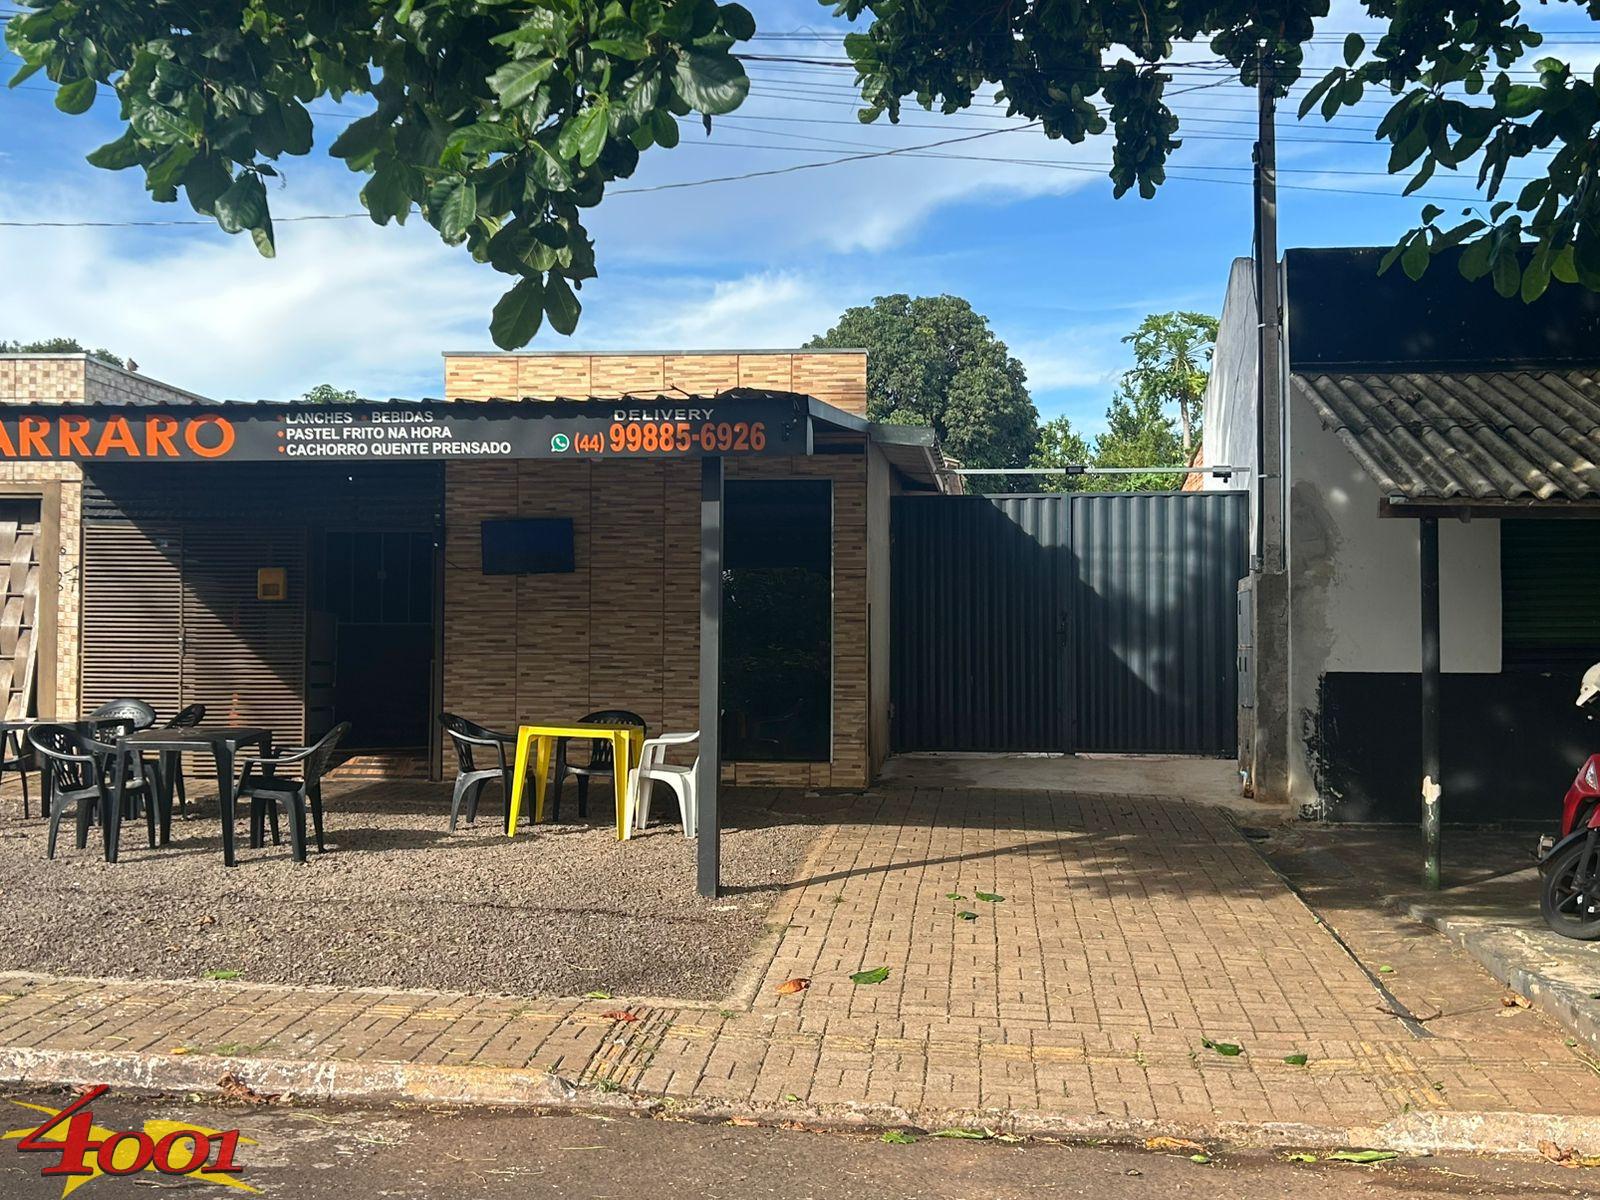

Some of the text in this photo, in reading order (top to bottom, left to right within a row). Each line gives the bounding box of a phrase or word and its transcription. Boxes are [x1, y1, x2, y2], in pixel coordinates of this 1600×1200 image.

[286, 410, 434, 424] LANCHES BEBIDAS
[614, 408, 714, 421] DELIVERY
[286, 426, 452, 440] PASTEL FRITO NA HORA
[573, 421, 766, 454] (44) 99885-6926
[286, 441, 511, 456] CACHORRO QUENTE PRENSADO
